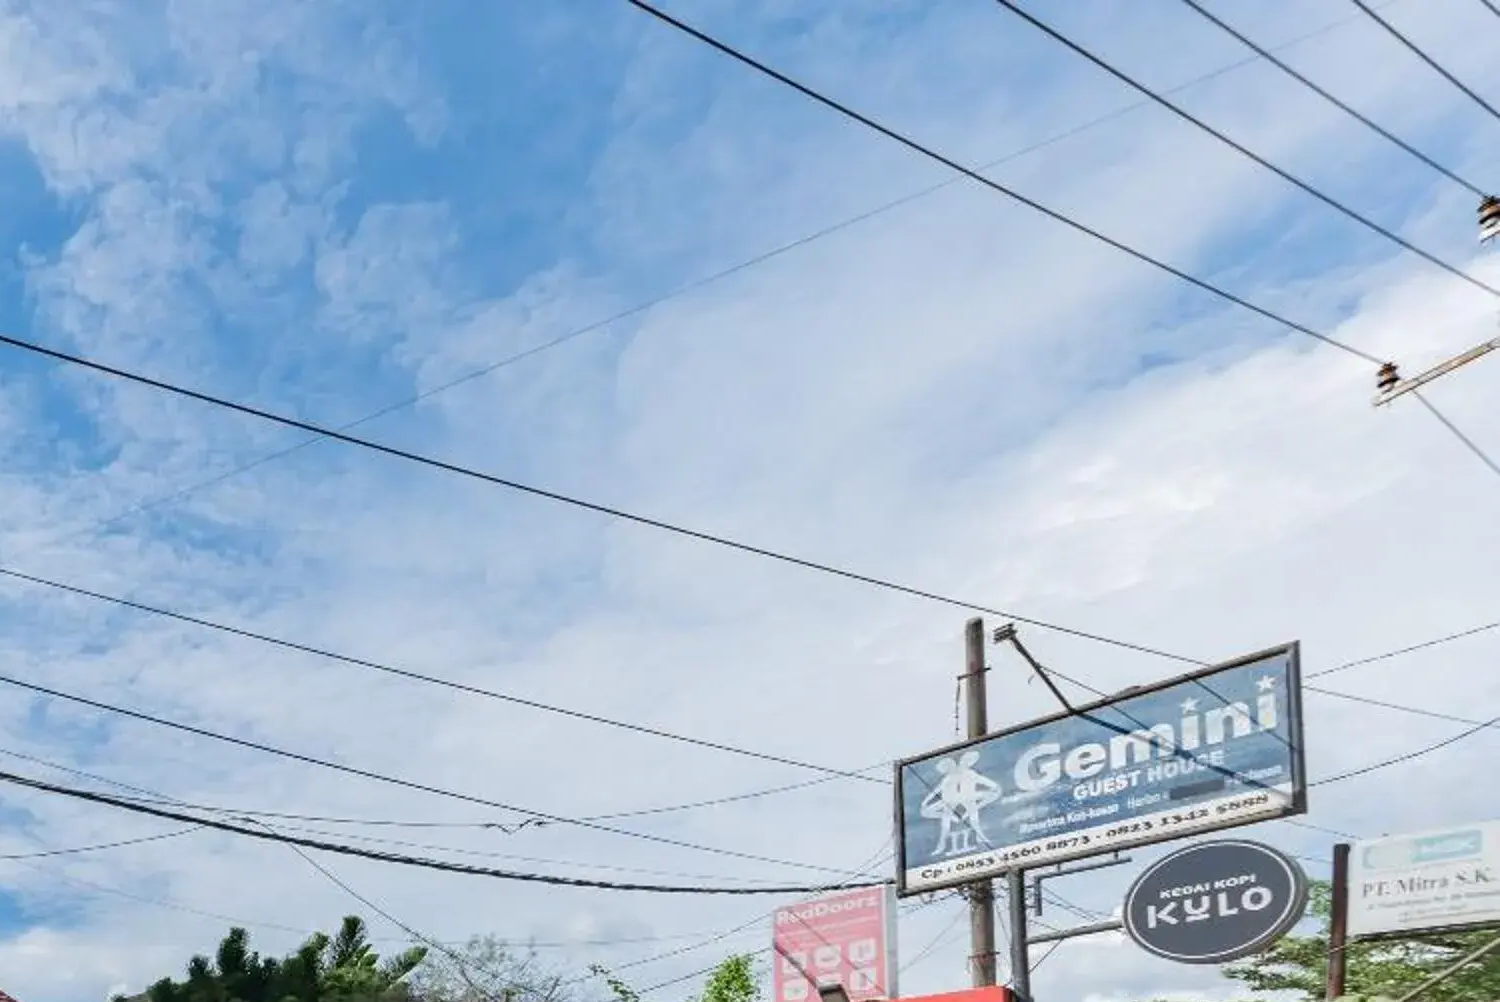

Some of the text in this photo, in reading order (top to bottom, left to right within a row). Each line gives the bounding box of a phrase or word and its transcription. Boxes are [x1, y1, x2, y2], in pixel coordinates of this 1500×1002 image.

[1014, 675, 1277, 791] Gemini
[1073, 770, 1142, 800] GUEST
[1147, 750, 1225, 781] HOUSE
[1147, 886, 1273, 929] KULO
[1159, 873, 1257, 899] KEDAI KOPI
